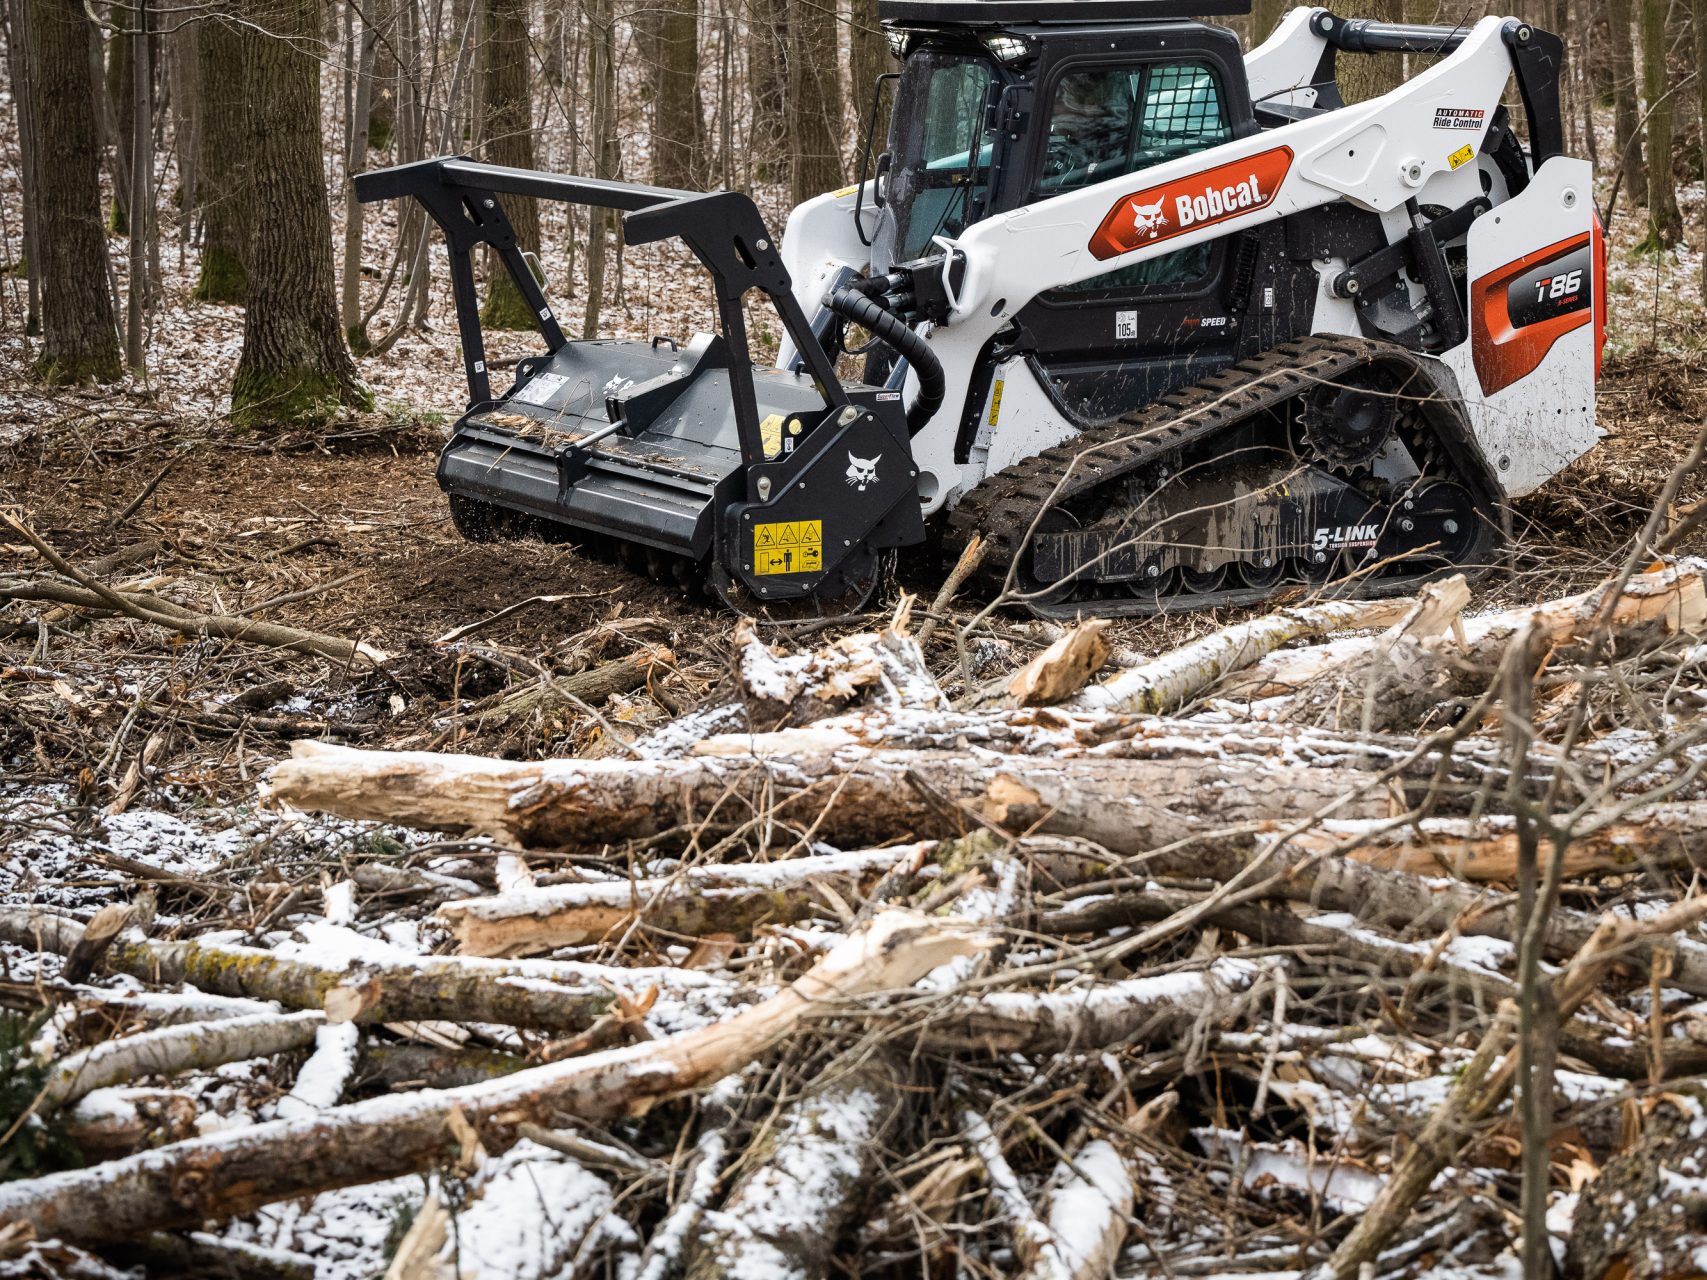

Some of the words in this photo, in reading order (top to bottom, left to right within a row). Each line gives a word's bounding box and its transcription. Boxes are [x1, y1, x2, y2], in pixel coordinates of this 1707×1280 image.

[1437, 109, 1483, 118] AUTOMATIC
[1433, 117, 1451, 127] Ride
[1453, 118, 1483, 128] Control
[1175, 174, 1262, 227] Bobcat
[1535, 269, 1583, 303] T86
[1200, 317, 1227, 327] SPEED
[1117, 323, 1132, 337] 105
[1311, 524, 1380, 551] 5-LINK
[1348, 540, 1377, 548] SUSPENSION
